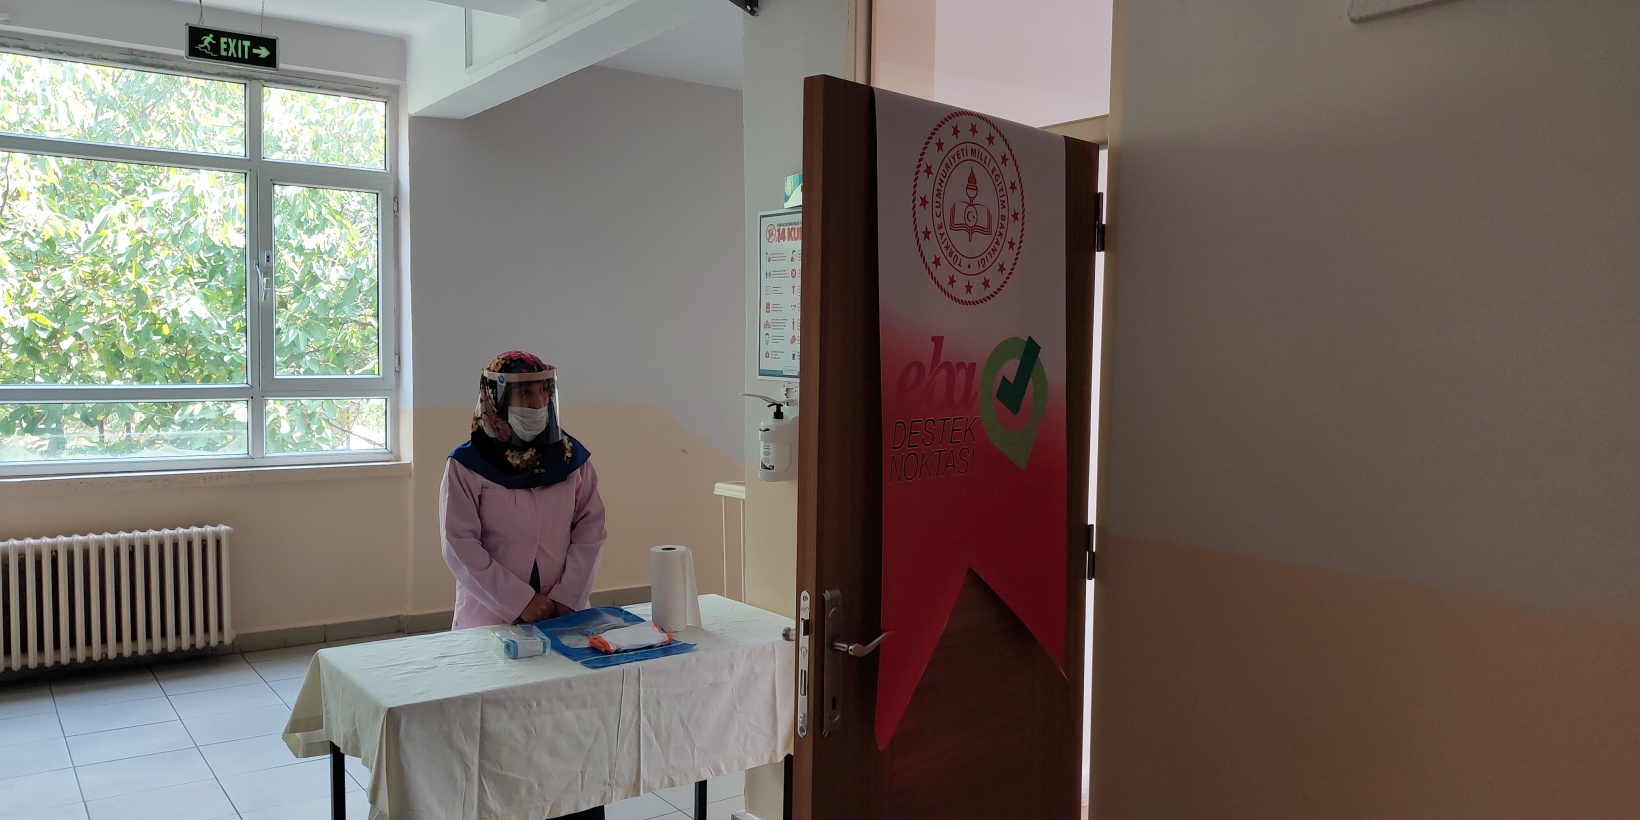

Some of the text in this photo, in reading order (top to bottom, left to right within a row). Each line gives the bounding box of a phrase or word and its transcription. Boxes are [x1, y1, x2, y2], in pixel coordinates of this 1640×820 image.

[220, 36, 251, 59] EXIT
[935, 145, 1006, 269] TÜRKİYE CUMHURİYETİ MİLLİ EĞİTİM BAKANLIĞI
[777, 227, 786, 243] 14
[897, 335, 979, 412] eba
[892, 416, 978, 450] DESTEK
[889, 447, 975, 484] NOKTASI
